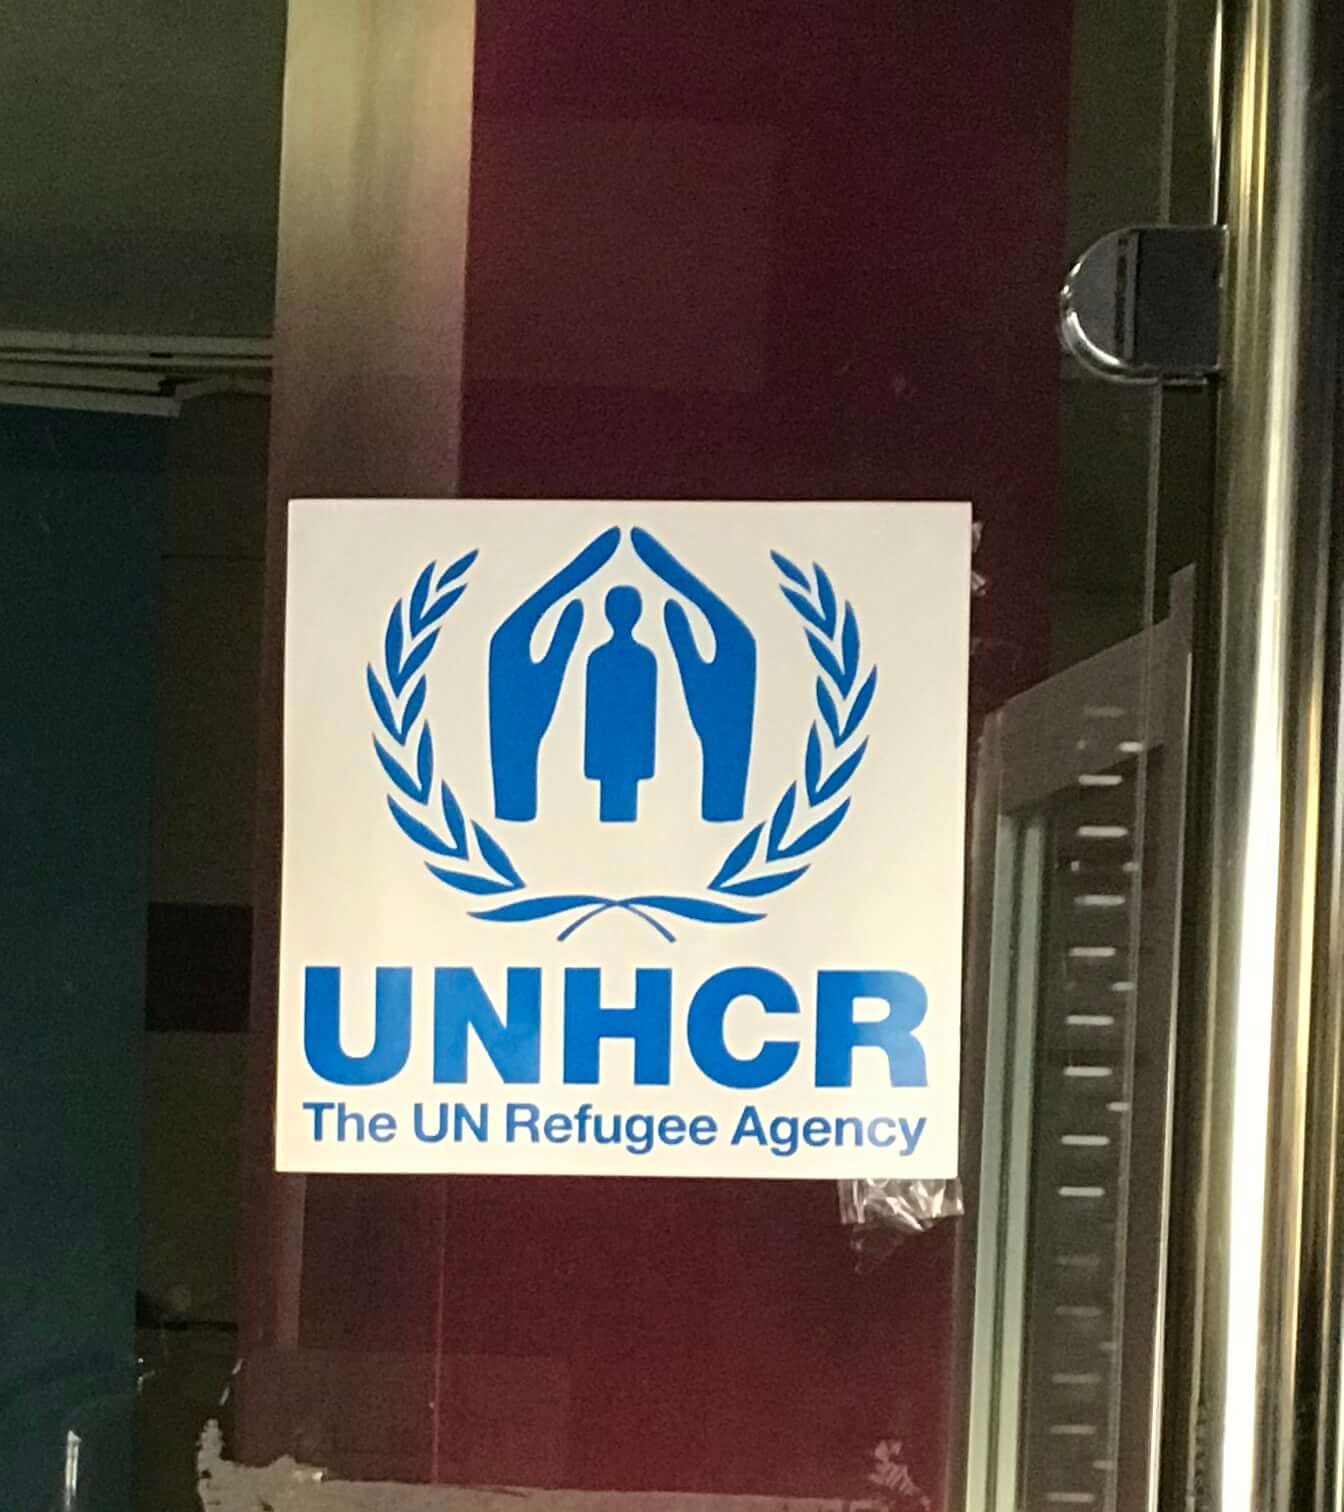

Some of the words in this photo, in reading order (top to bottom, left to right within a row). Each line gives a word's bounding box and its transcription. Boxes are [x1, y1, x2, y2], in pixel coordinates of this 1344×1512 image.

[302, 965, 929, 1090] UNHCR
[302, 1101, 398, 1143] The
[412, 1102, 489, 1143] UN
[505, 1103, 718, 1154] Refugee
[730, 1105, 928, 1157] Agency
